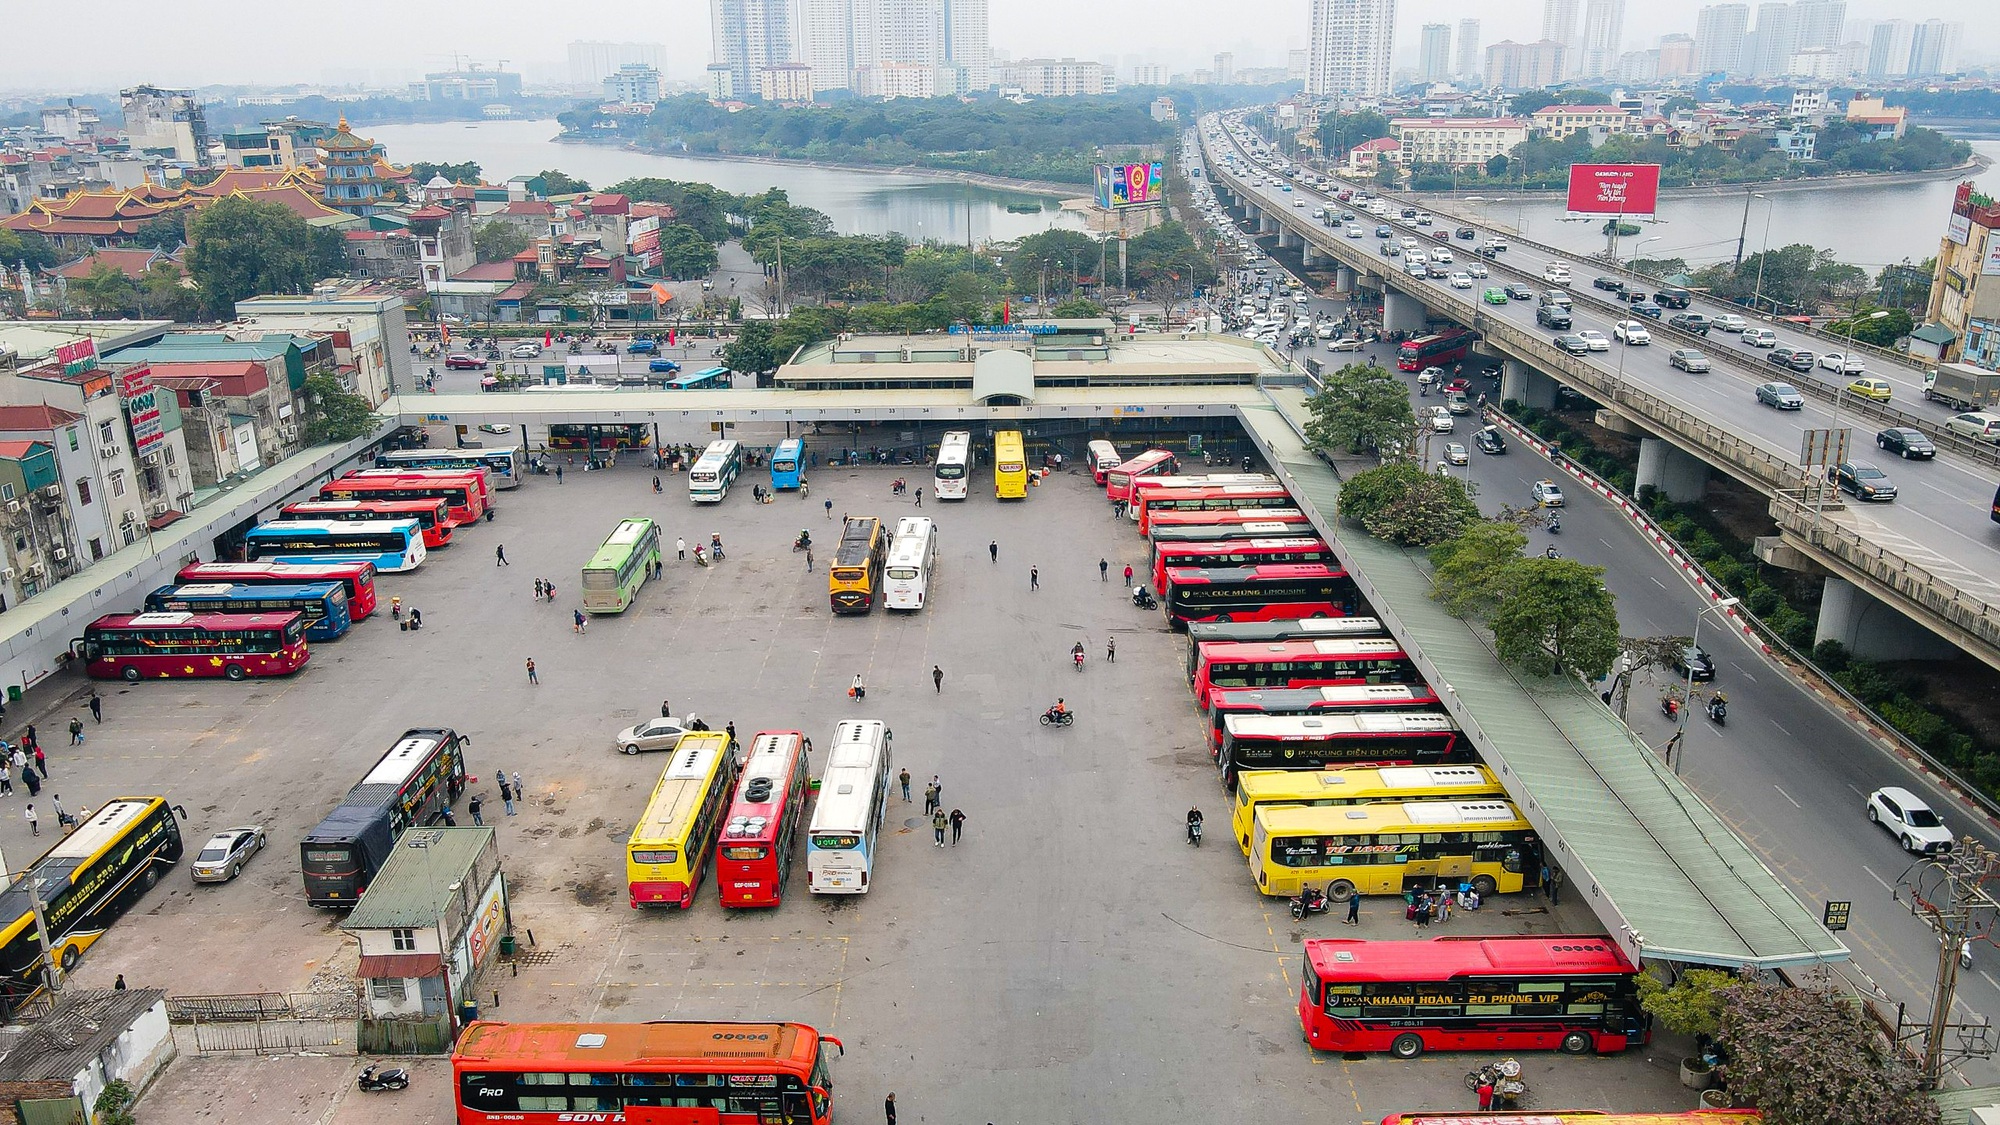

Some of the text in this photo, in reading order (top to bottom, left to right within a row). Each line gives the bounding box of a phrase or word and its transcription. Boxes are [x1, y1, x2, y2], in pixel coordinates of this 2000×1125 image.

[973, 325, 988, 334] XE
[94, 588, 102, 598] 09
[62, 608, 69, 616] 08
[25, 628, 33, 637] 07
[1530, 801, 1535, 812] 61
[1558, 840, 1564, 852] 62
[1592, 884, 1599, 897] 63
[1372, 995, 1414, 1004] KHÁNH
[1420, 994, 1453, 1004] HOÀN
[1492, 994, 1532, 1003] PHÒNG
